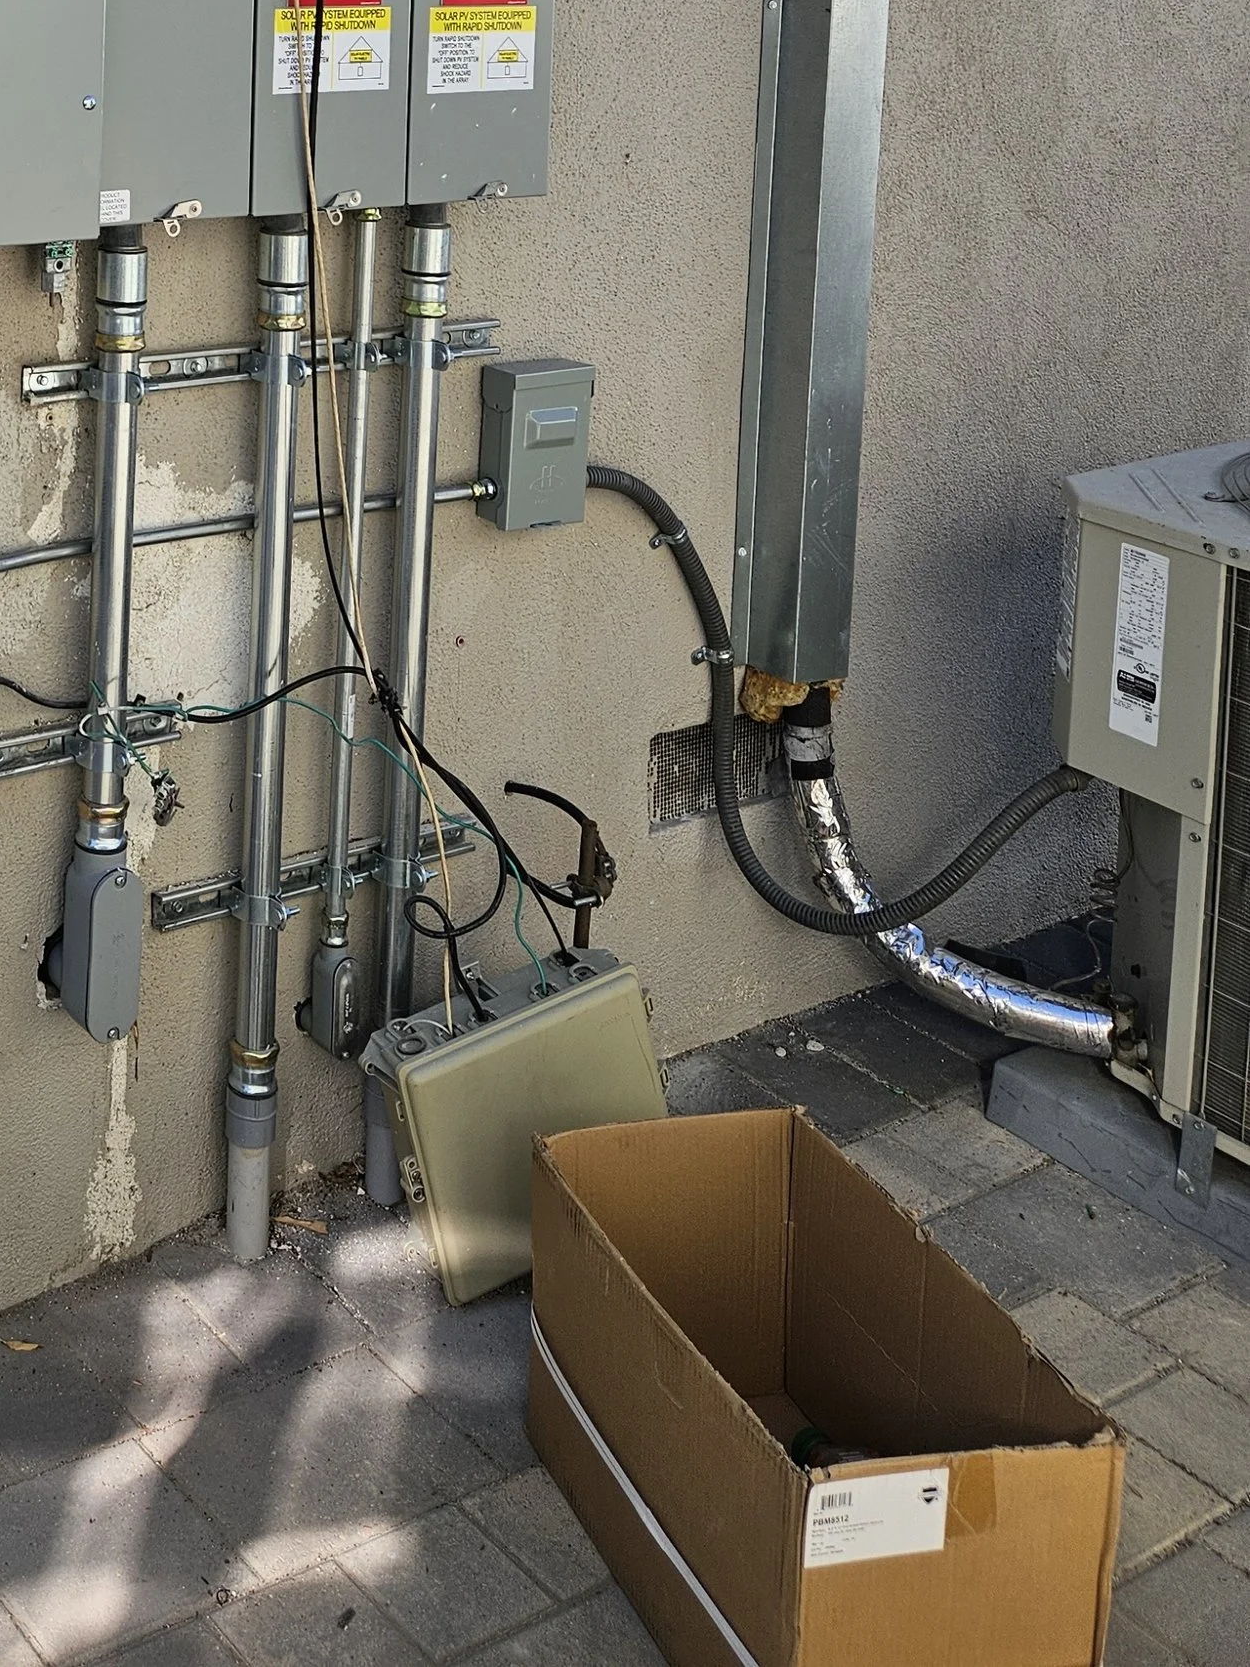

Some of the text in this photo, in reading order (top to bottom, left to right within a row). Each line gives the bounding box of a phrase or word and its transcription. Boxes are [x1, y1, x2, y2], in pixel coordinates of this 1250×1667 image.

[281, 11, 306, 20] SOLR
[324, 10, 348, 19] YSTEM
[350, 9, 385, 18] EQUIPPED
[435, 11, 531, 21] SOLAR PV SYSTEM EQUIPPED
[291, 21, 376, 31] WTH RPID SHUTDOWN
[443, 22, 522, 31] WITH RAPID SHUTDOWN
